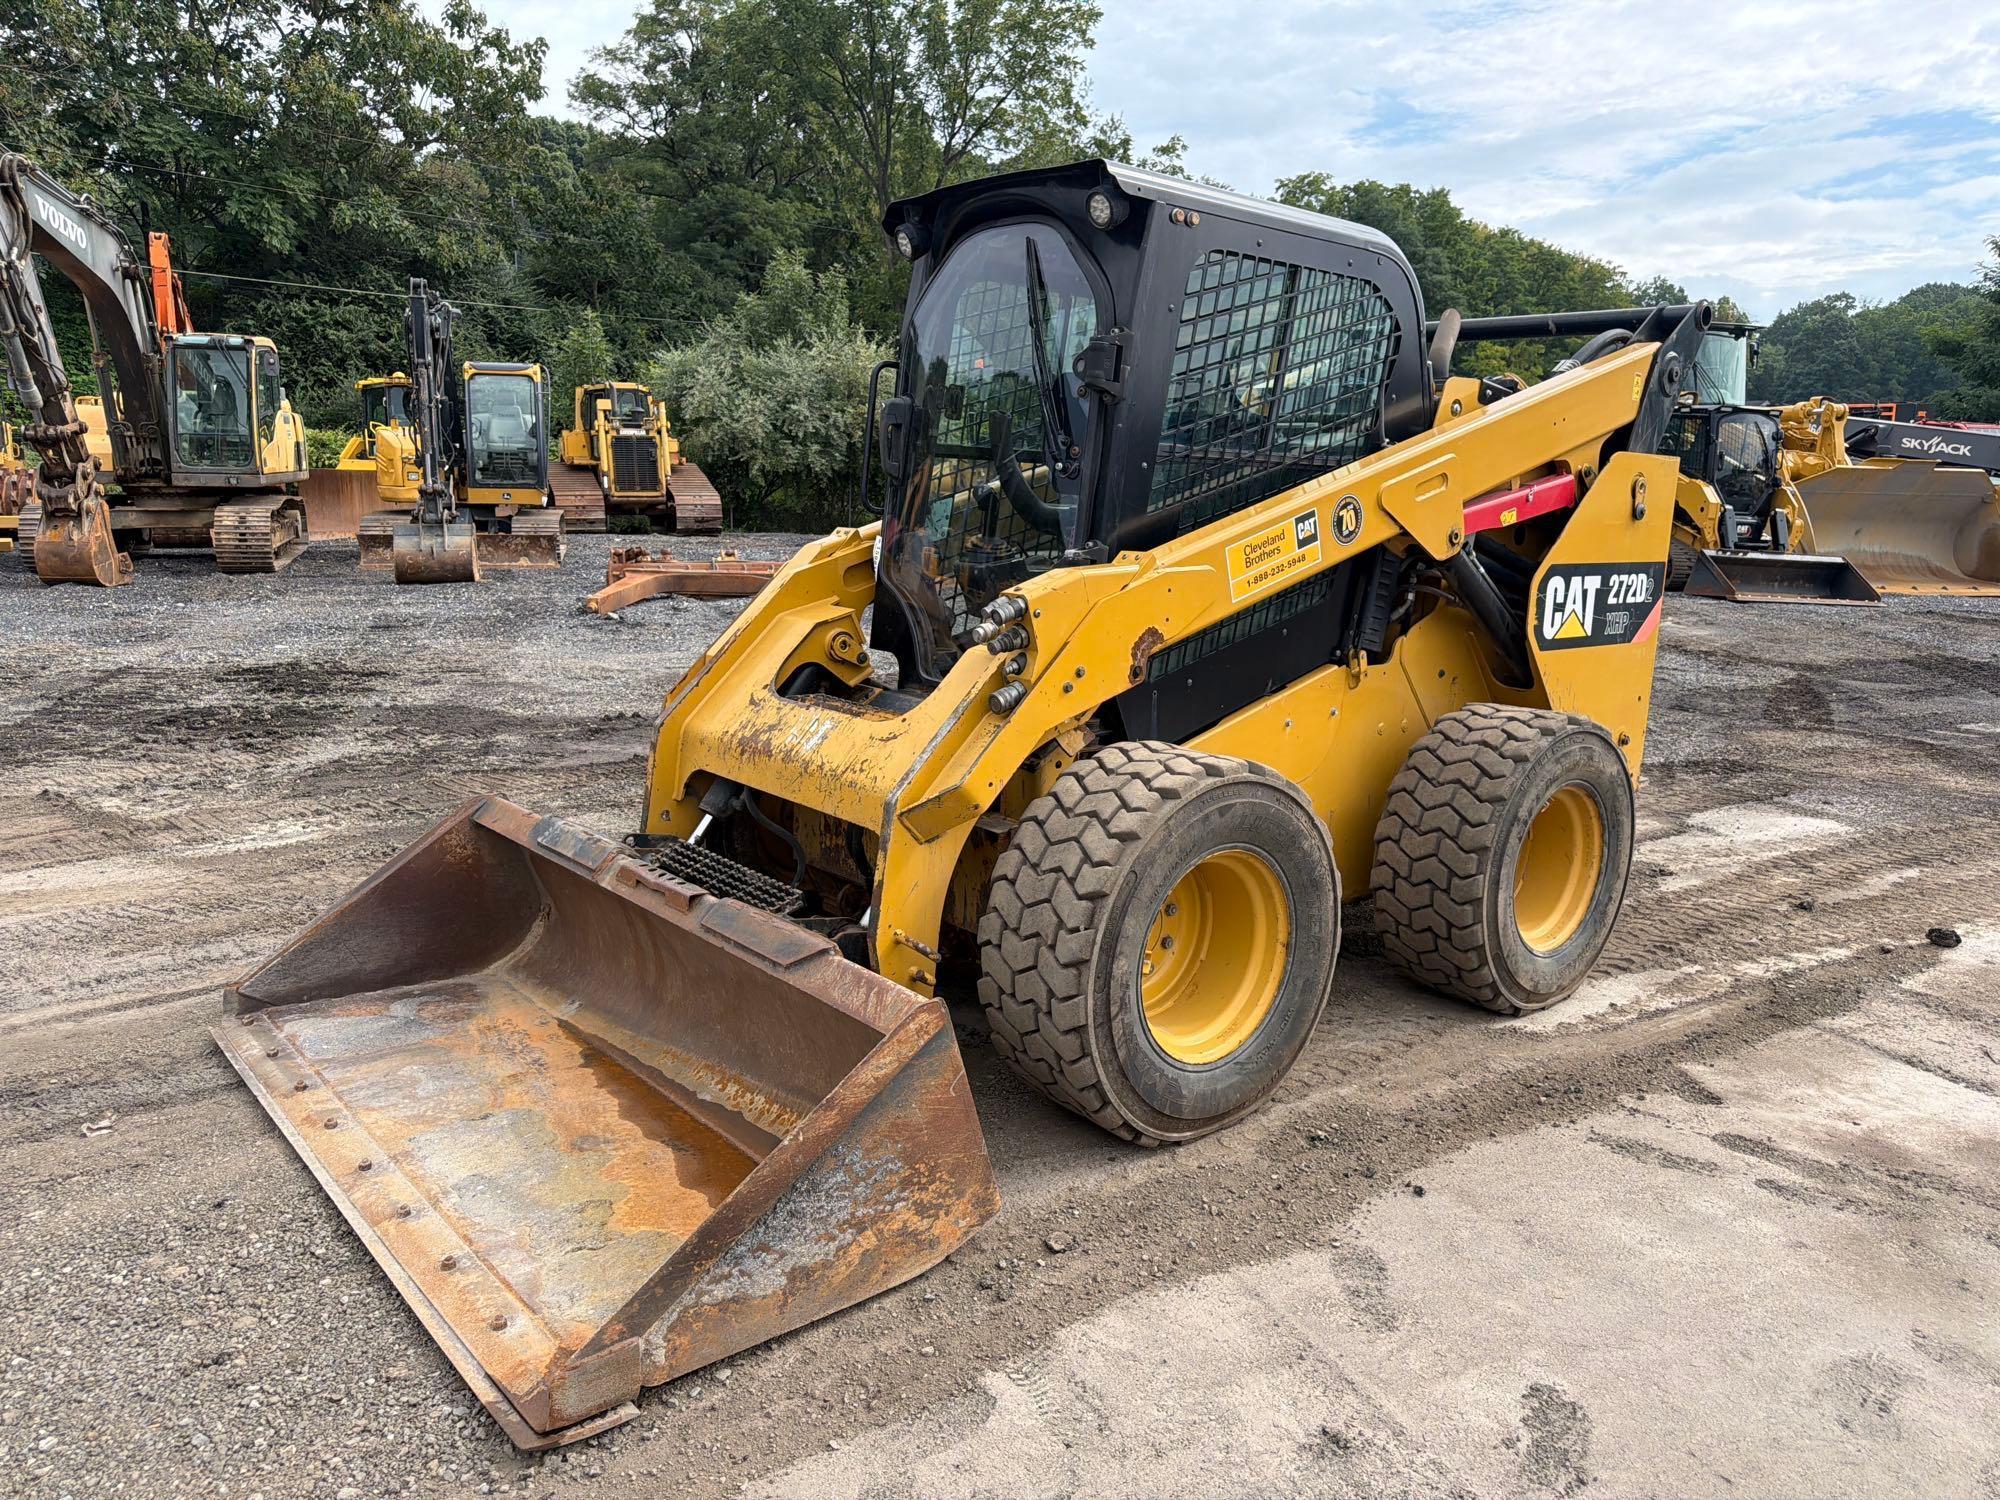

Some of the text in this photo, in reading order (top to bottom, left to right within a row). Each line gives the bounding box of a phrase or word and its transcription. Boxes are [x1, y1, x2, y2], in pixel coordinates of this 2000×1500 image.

[34, 193, 87, 249] VOLVO
[1901, 435, 1972, 457] SKYJACK
[1243, 529, 1286, 557] Cleveland
[1297, 518, 1317, 540] CAT
[1244, 545, 1281, 569] Brothers
[1246, 553, 1307, 588] 1-888-232-5948
[1543, 575, 1601, 640] CAT
